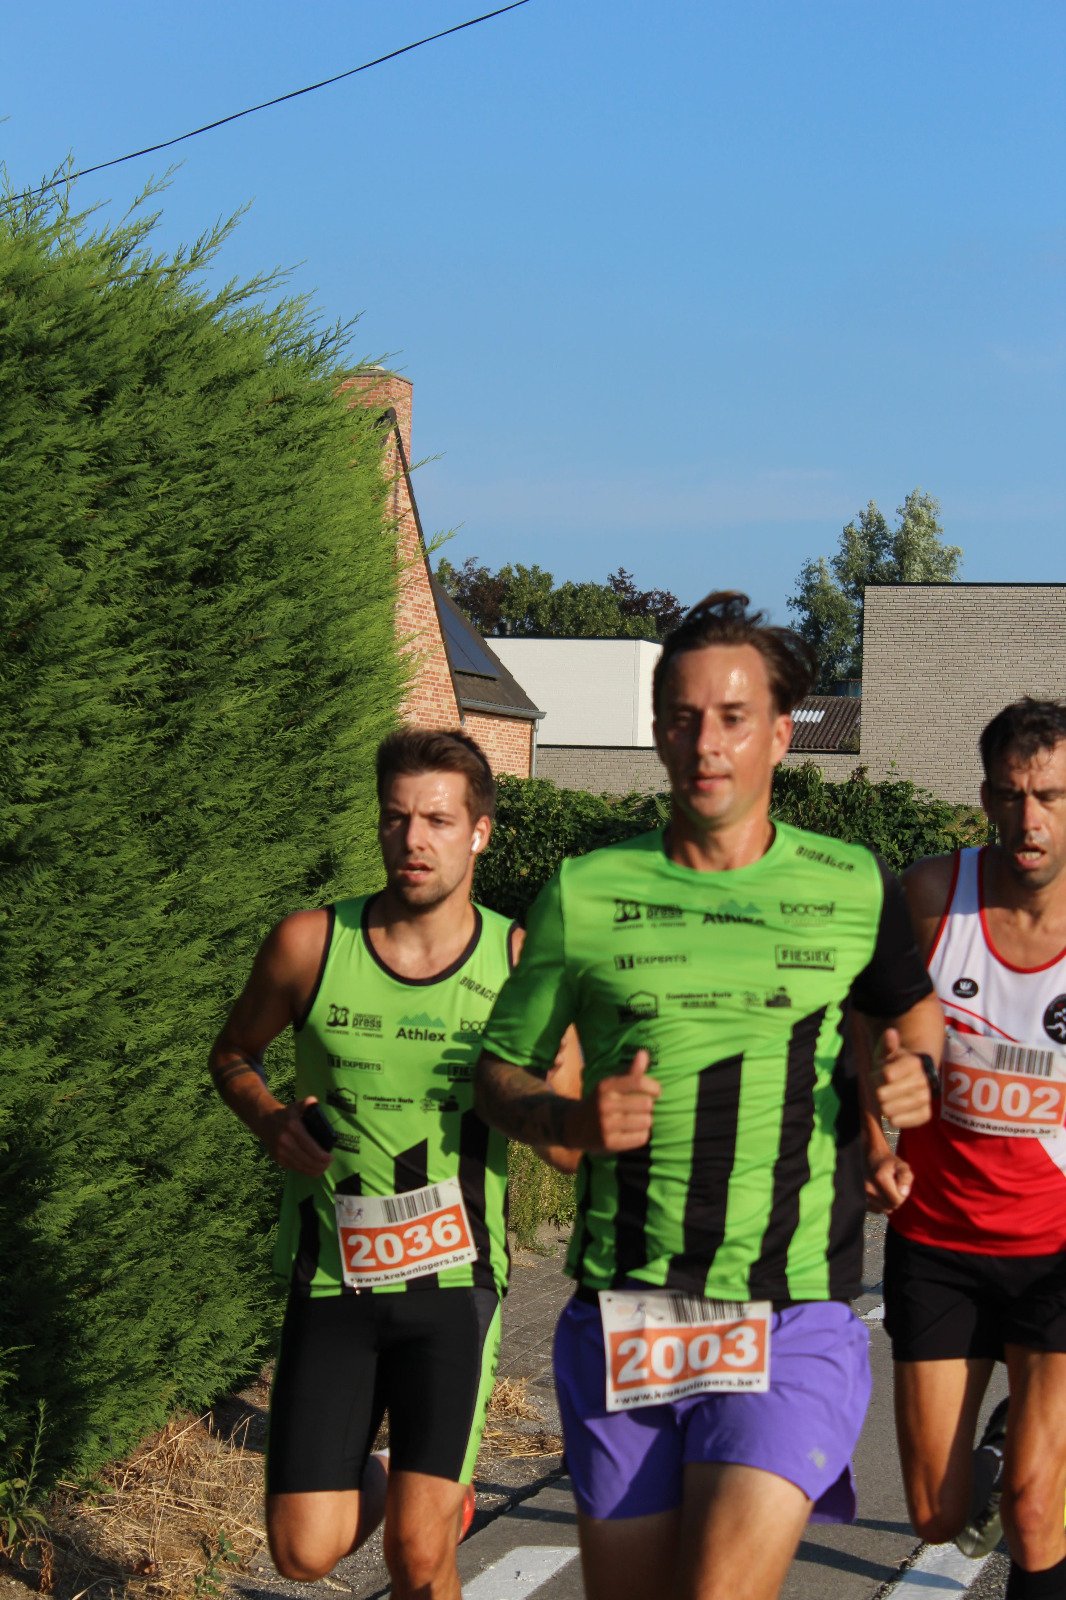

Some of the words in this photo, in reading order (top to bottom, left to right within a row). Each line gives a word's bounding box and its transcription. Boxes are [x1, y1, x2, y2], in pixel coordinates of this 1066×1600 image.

[395, 1027, 446, 1042] Athlex
[342, 1059, 382, 1072] EXPERTS
[947, 1071, 1060, 1120] 2002
[347, 1213, 461, 1267] 2036
[617, 1325, 759, 1384] 2003
